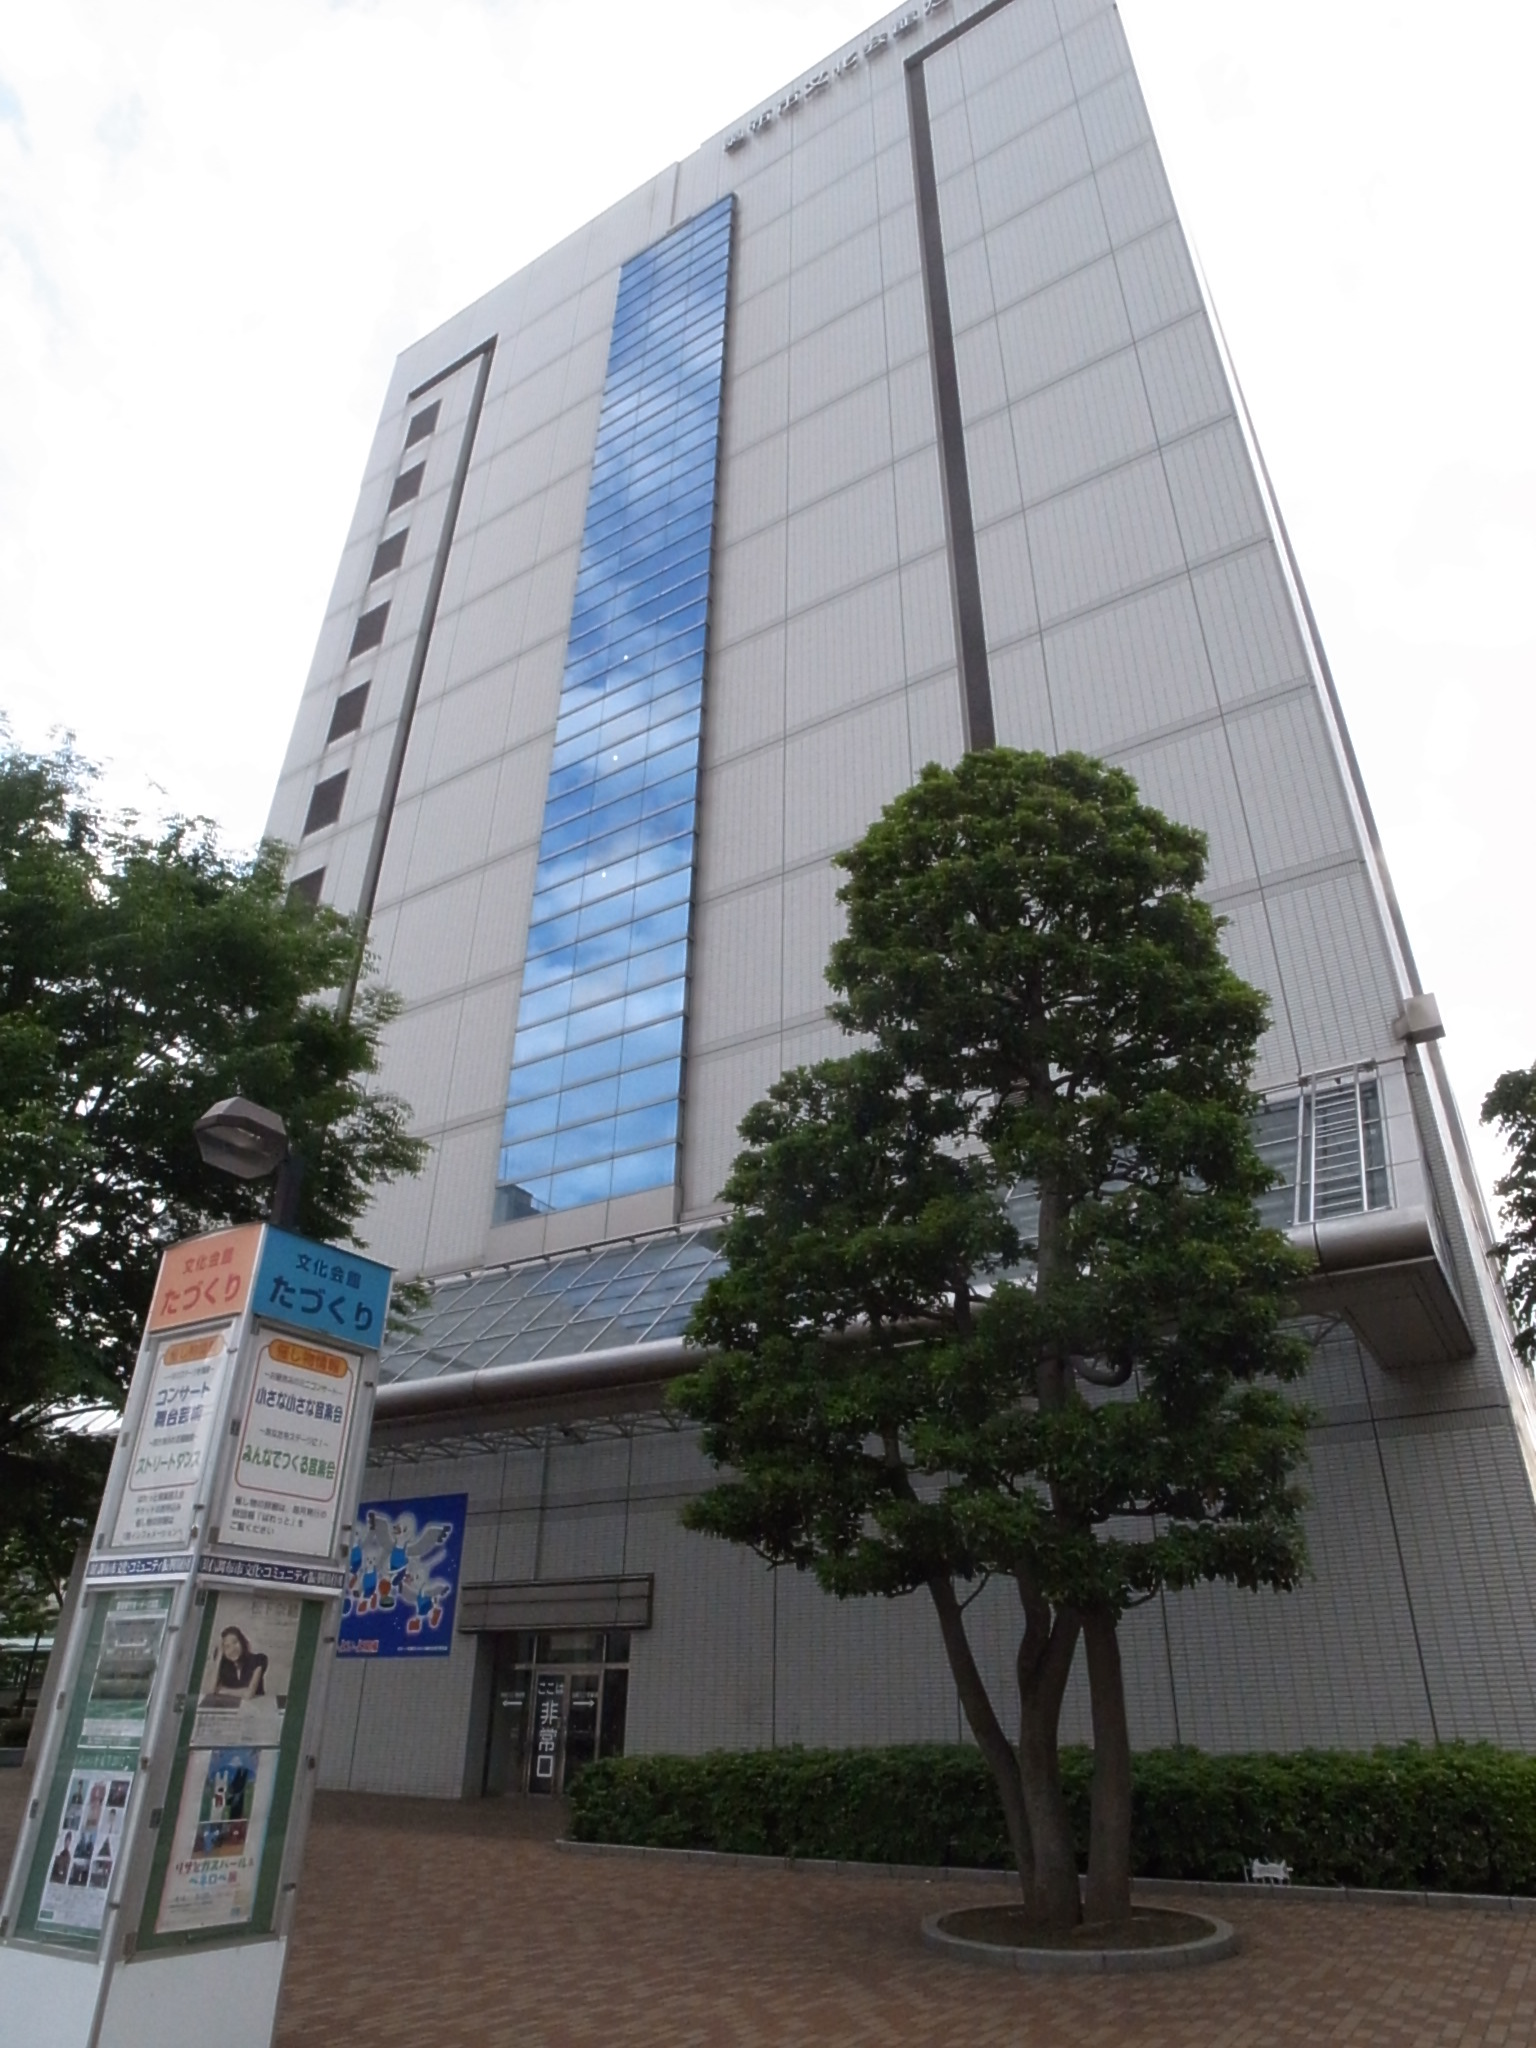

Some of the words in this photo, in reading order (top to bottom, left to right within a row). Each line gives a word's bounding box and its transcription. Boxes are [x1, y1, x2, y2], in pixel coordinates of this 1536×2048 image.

[182, 1247, 234, 1275] 文化会館
[296, 1253, 362, 1290] 文化会館
[161, 1273, 241, 1317] たづくり
[269, 1275, 373, 1331] たづくり
[156, 1381, 211, 1407] コンサート
[255, 1386, 343, 1424] 小さな小さな音楽会
[242, 1444, 336, 1480] みんなでつくる音楽会
[538, 1682, 564, 1695] ここは
[536, 1700, 559, 1778] 非常口
